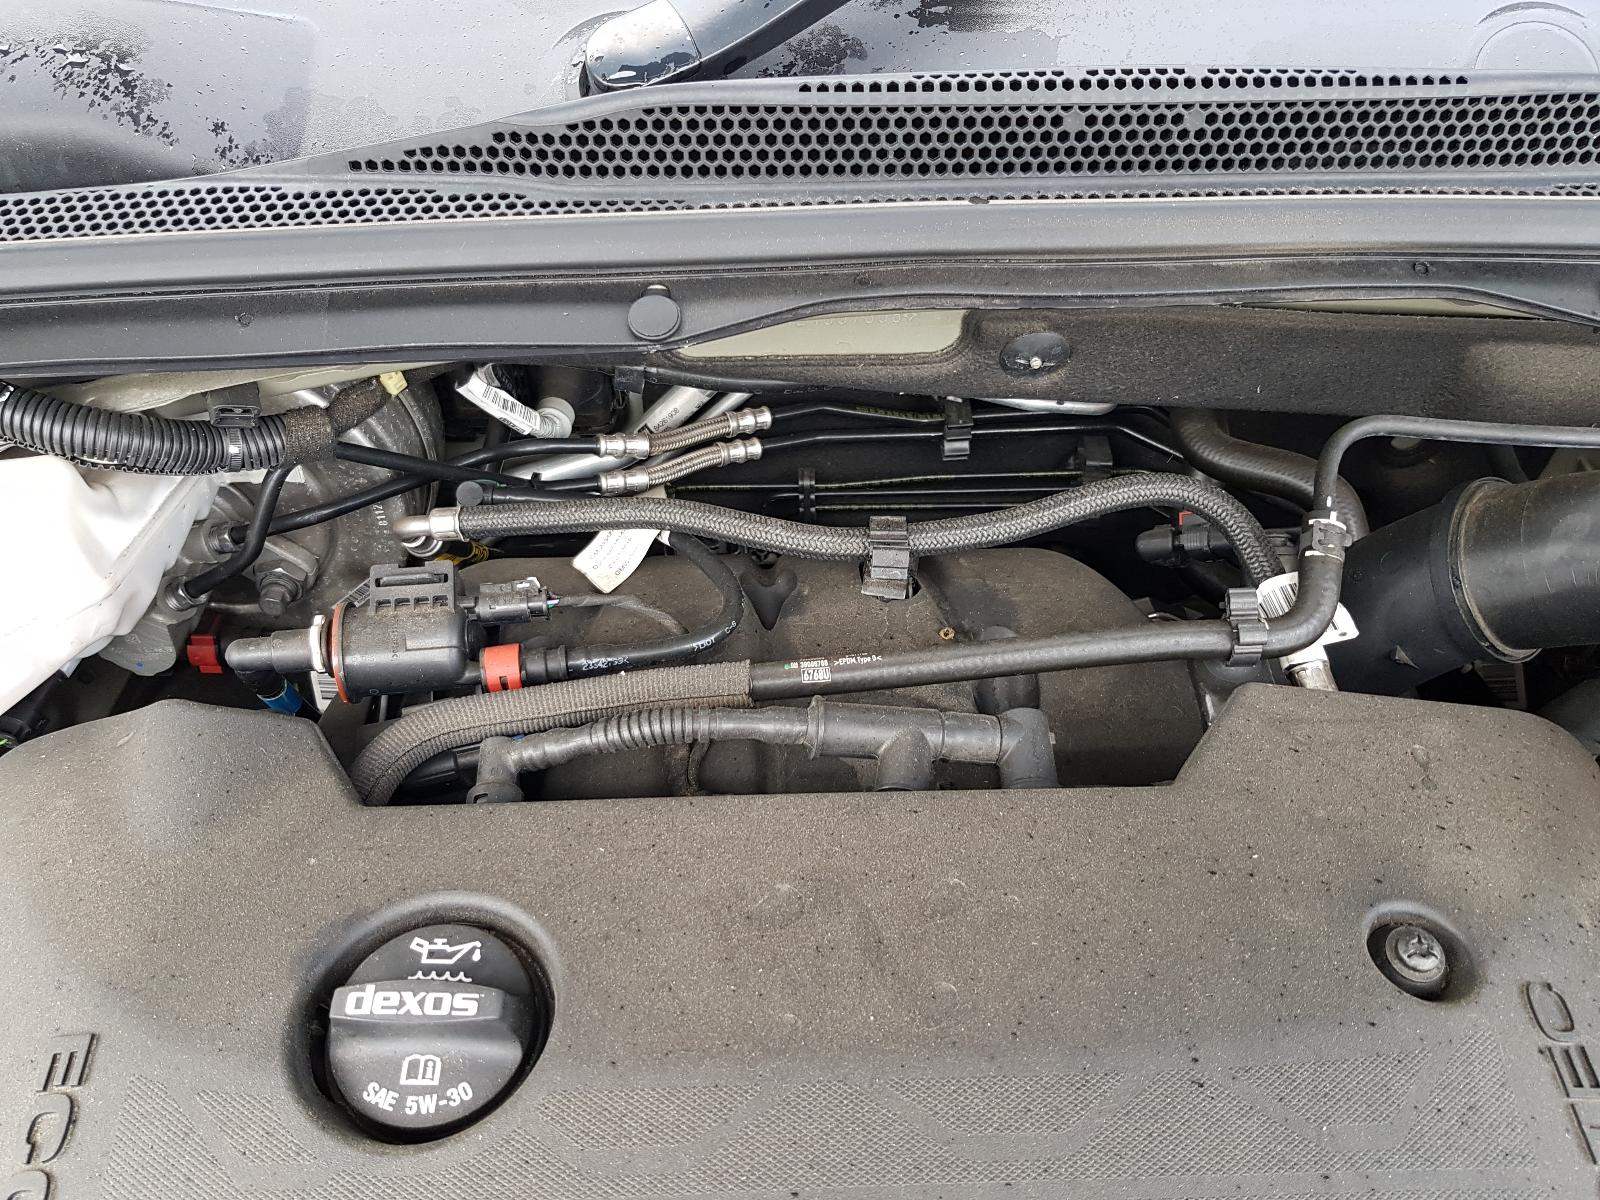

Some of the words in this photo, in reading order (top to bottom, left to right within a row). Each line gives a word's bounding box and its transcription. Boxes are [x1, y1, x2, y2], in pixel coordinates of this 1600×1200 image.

[345, 984, 480, 1016] dexos
[363, 1082, 399, 1111] SAE
[405, 1081, 473, 1114] 5W-30
